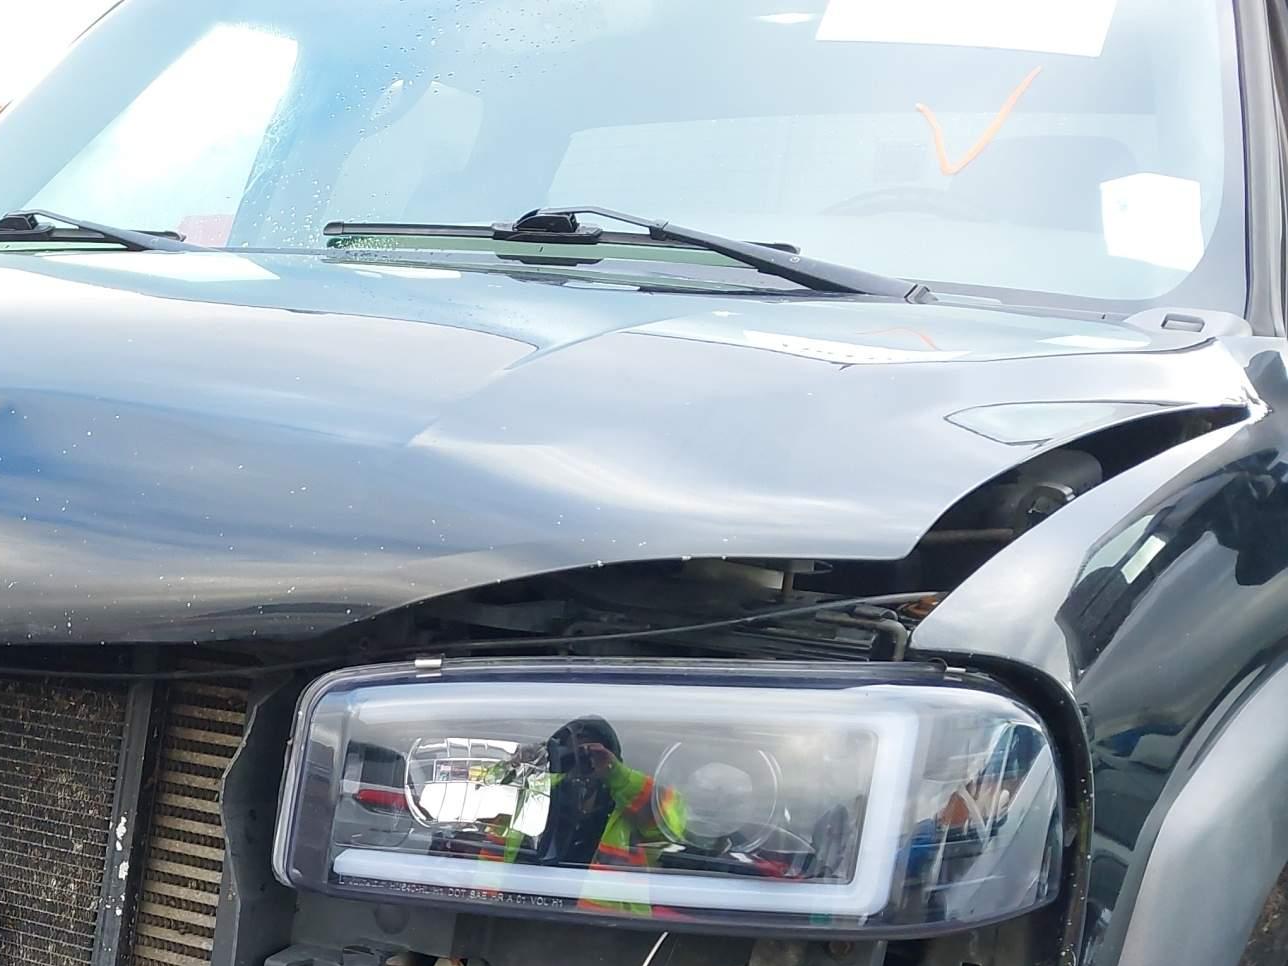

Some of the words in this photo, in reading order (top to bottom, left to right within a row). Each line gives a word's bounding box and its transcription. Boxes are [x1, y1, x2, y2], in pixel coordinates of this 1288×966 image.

[447, 888, 467, 898] DOT
[470, 889, 488, 900] SAE
[530, 896, 549, 907] VOL
